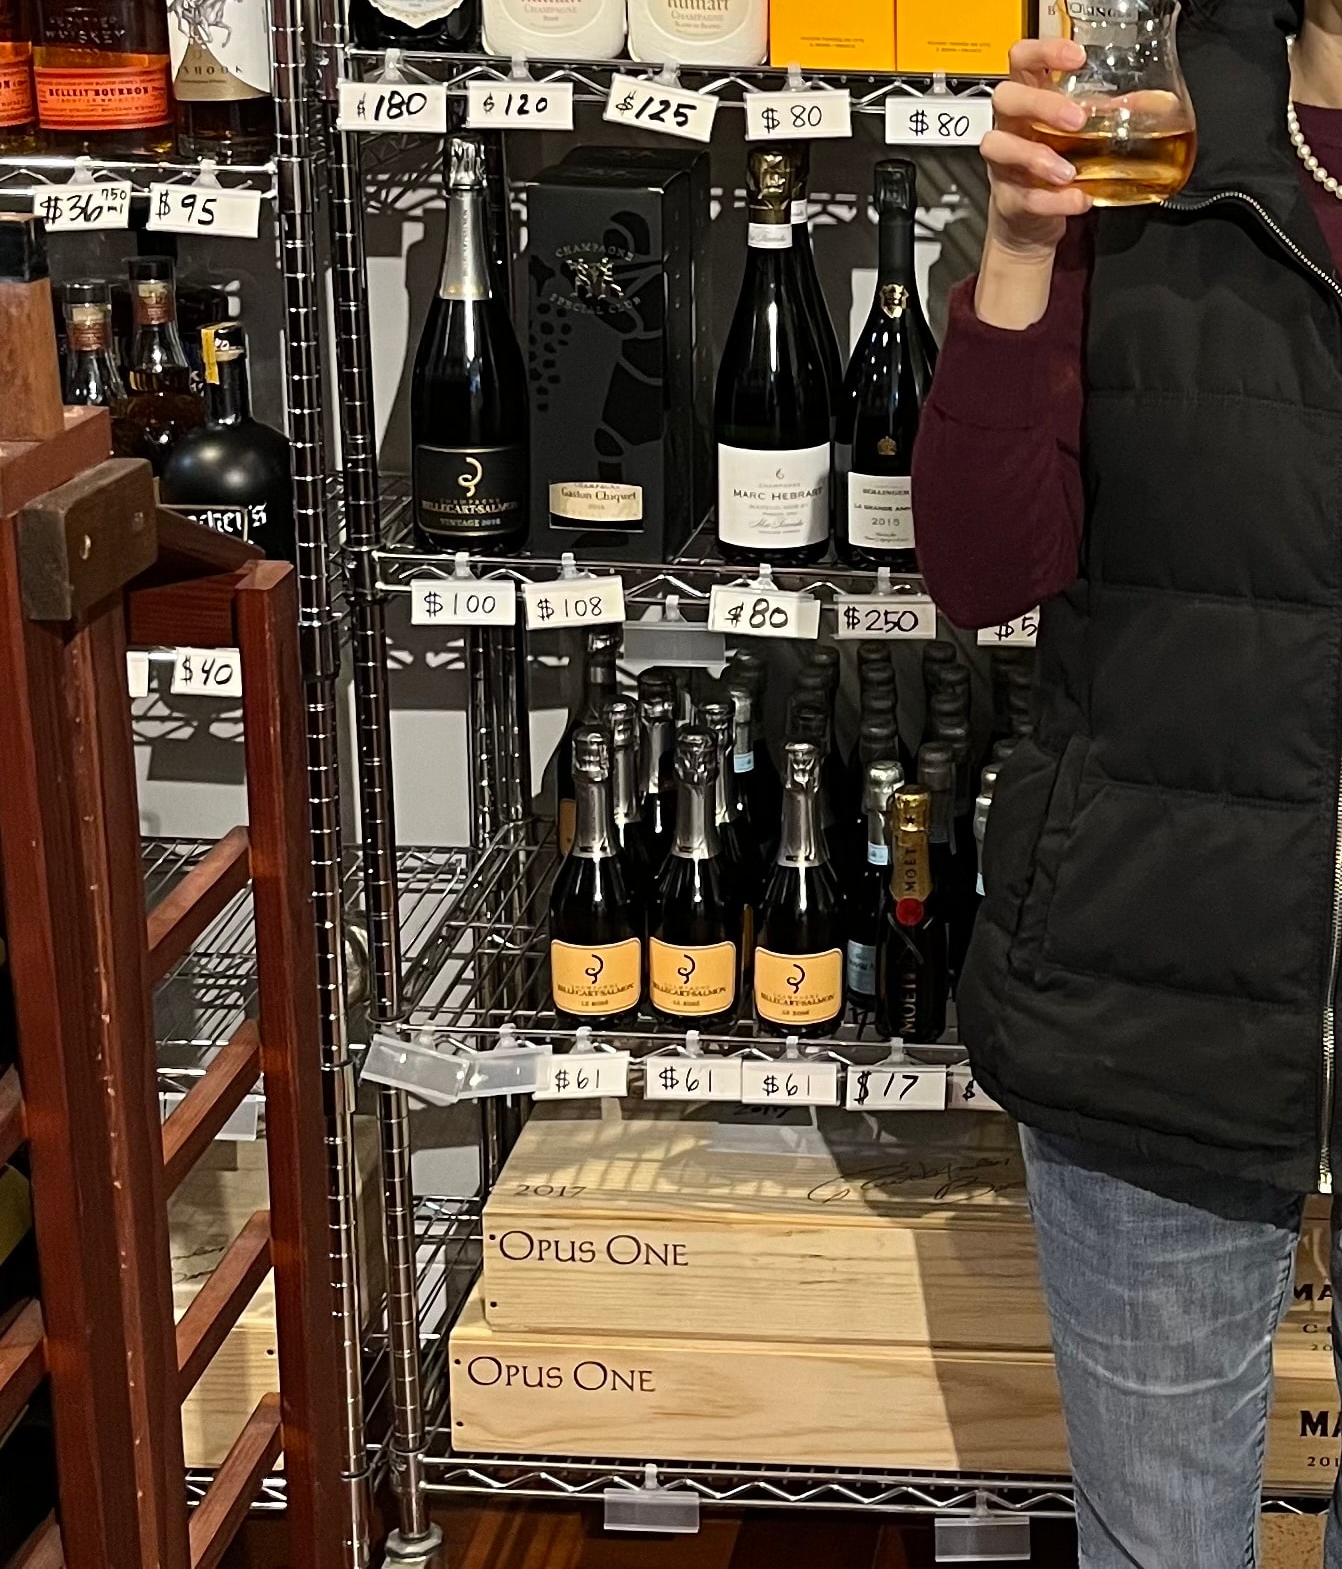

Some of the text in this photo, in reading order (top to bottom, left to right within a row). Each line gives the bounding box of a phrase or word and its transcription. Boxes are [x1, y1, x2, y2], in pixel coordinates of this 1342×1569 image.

[93, 86, 150, 98] BOURBON
[482, 91, 548, 117] $120
[616, 91, 696, 127] $125
[908, 108, 970, 138] $80
[561, 487, 637, 504] Gaston Chiquet
[733, 486, 823, 502] MARC HEBRART
[439, 517, 480, 527] VINTAGE
[423, 590, 496, 618] $100
[536, 595, 607, 625] $108
[842, 606, 919, 633] $250
[180, 654, 234, 687] $40
[554, 1067, 600, 1093] $61
[658, 1065, 712, 1093] $61
[761, 1072, 811, 1097] $61
[513, 1183, 588, 1199] 2017
[499, 1230, 690, 1268] OPUS ONE
[466, 1356, 657, 1393] OPUS ONE
